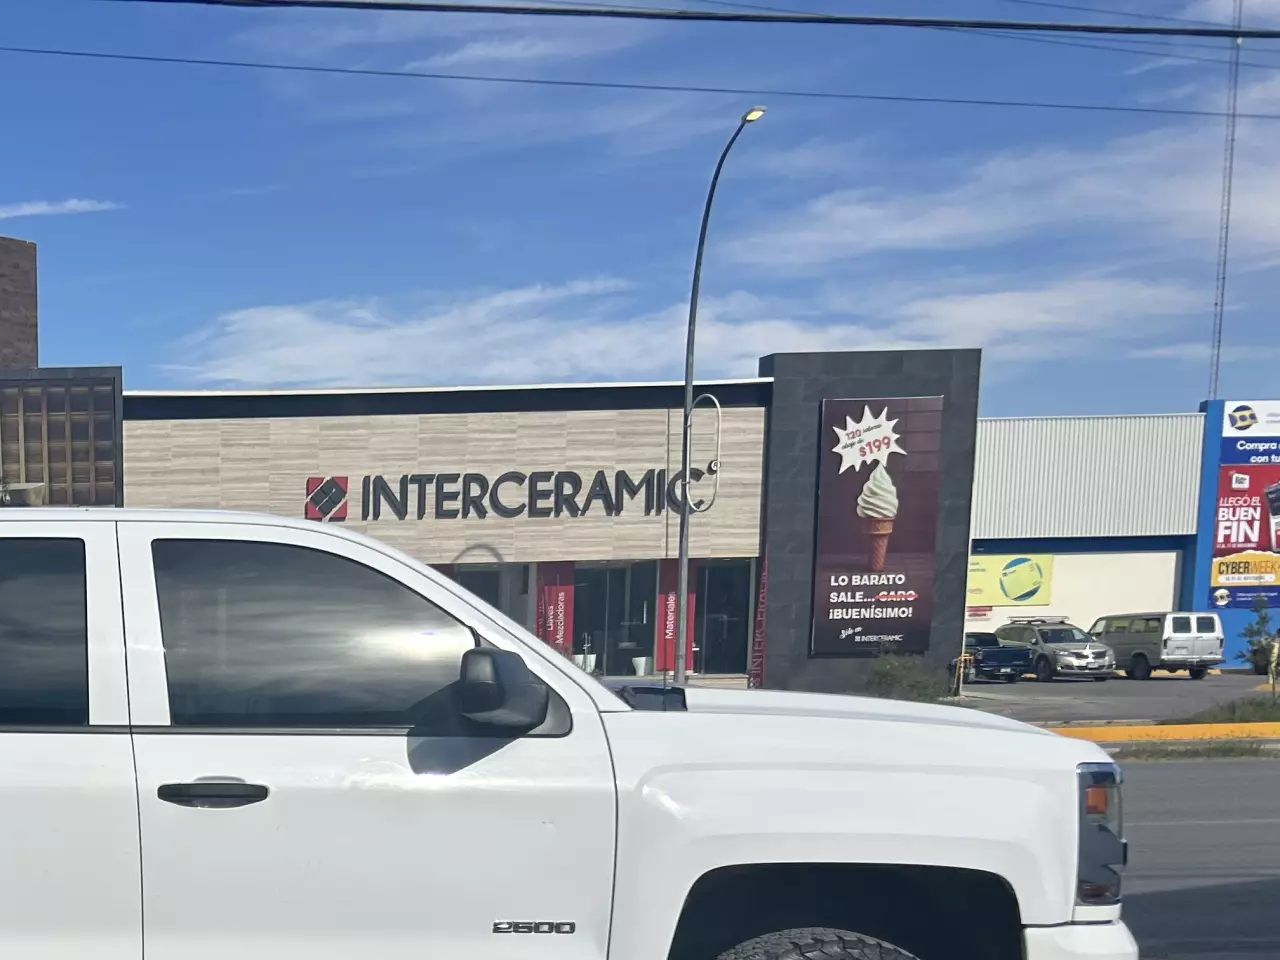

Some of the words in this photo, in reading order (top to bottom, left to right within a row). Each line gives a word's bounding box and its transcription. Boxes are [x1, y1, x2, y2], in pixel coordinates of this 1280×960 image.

[845, 429, 862, 440] 120
[859, 435, 891, 457] $199
[1236, 440, 1277, 452] Compra
[1250, 455, 1269, 463] con
[361, 468, 706, 521] INTERCERAMIC
[1218, 506, 1262, 520] BUEN
[1217, 520, 1261, 543] FIN
[830, 575, 849, 586] LO
[851, 574, 906, 585] BARATO
[829, 591, 876, 602] SALE...
[555, 592, 565, 644] Mezcladoras
[828, 604, 913, 620] ¡BUENÍSIMO!
[492, 921, 576, 934] 2500
